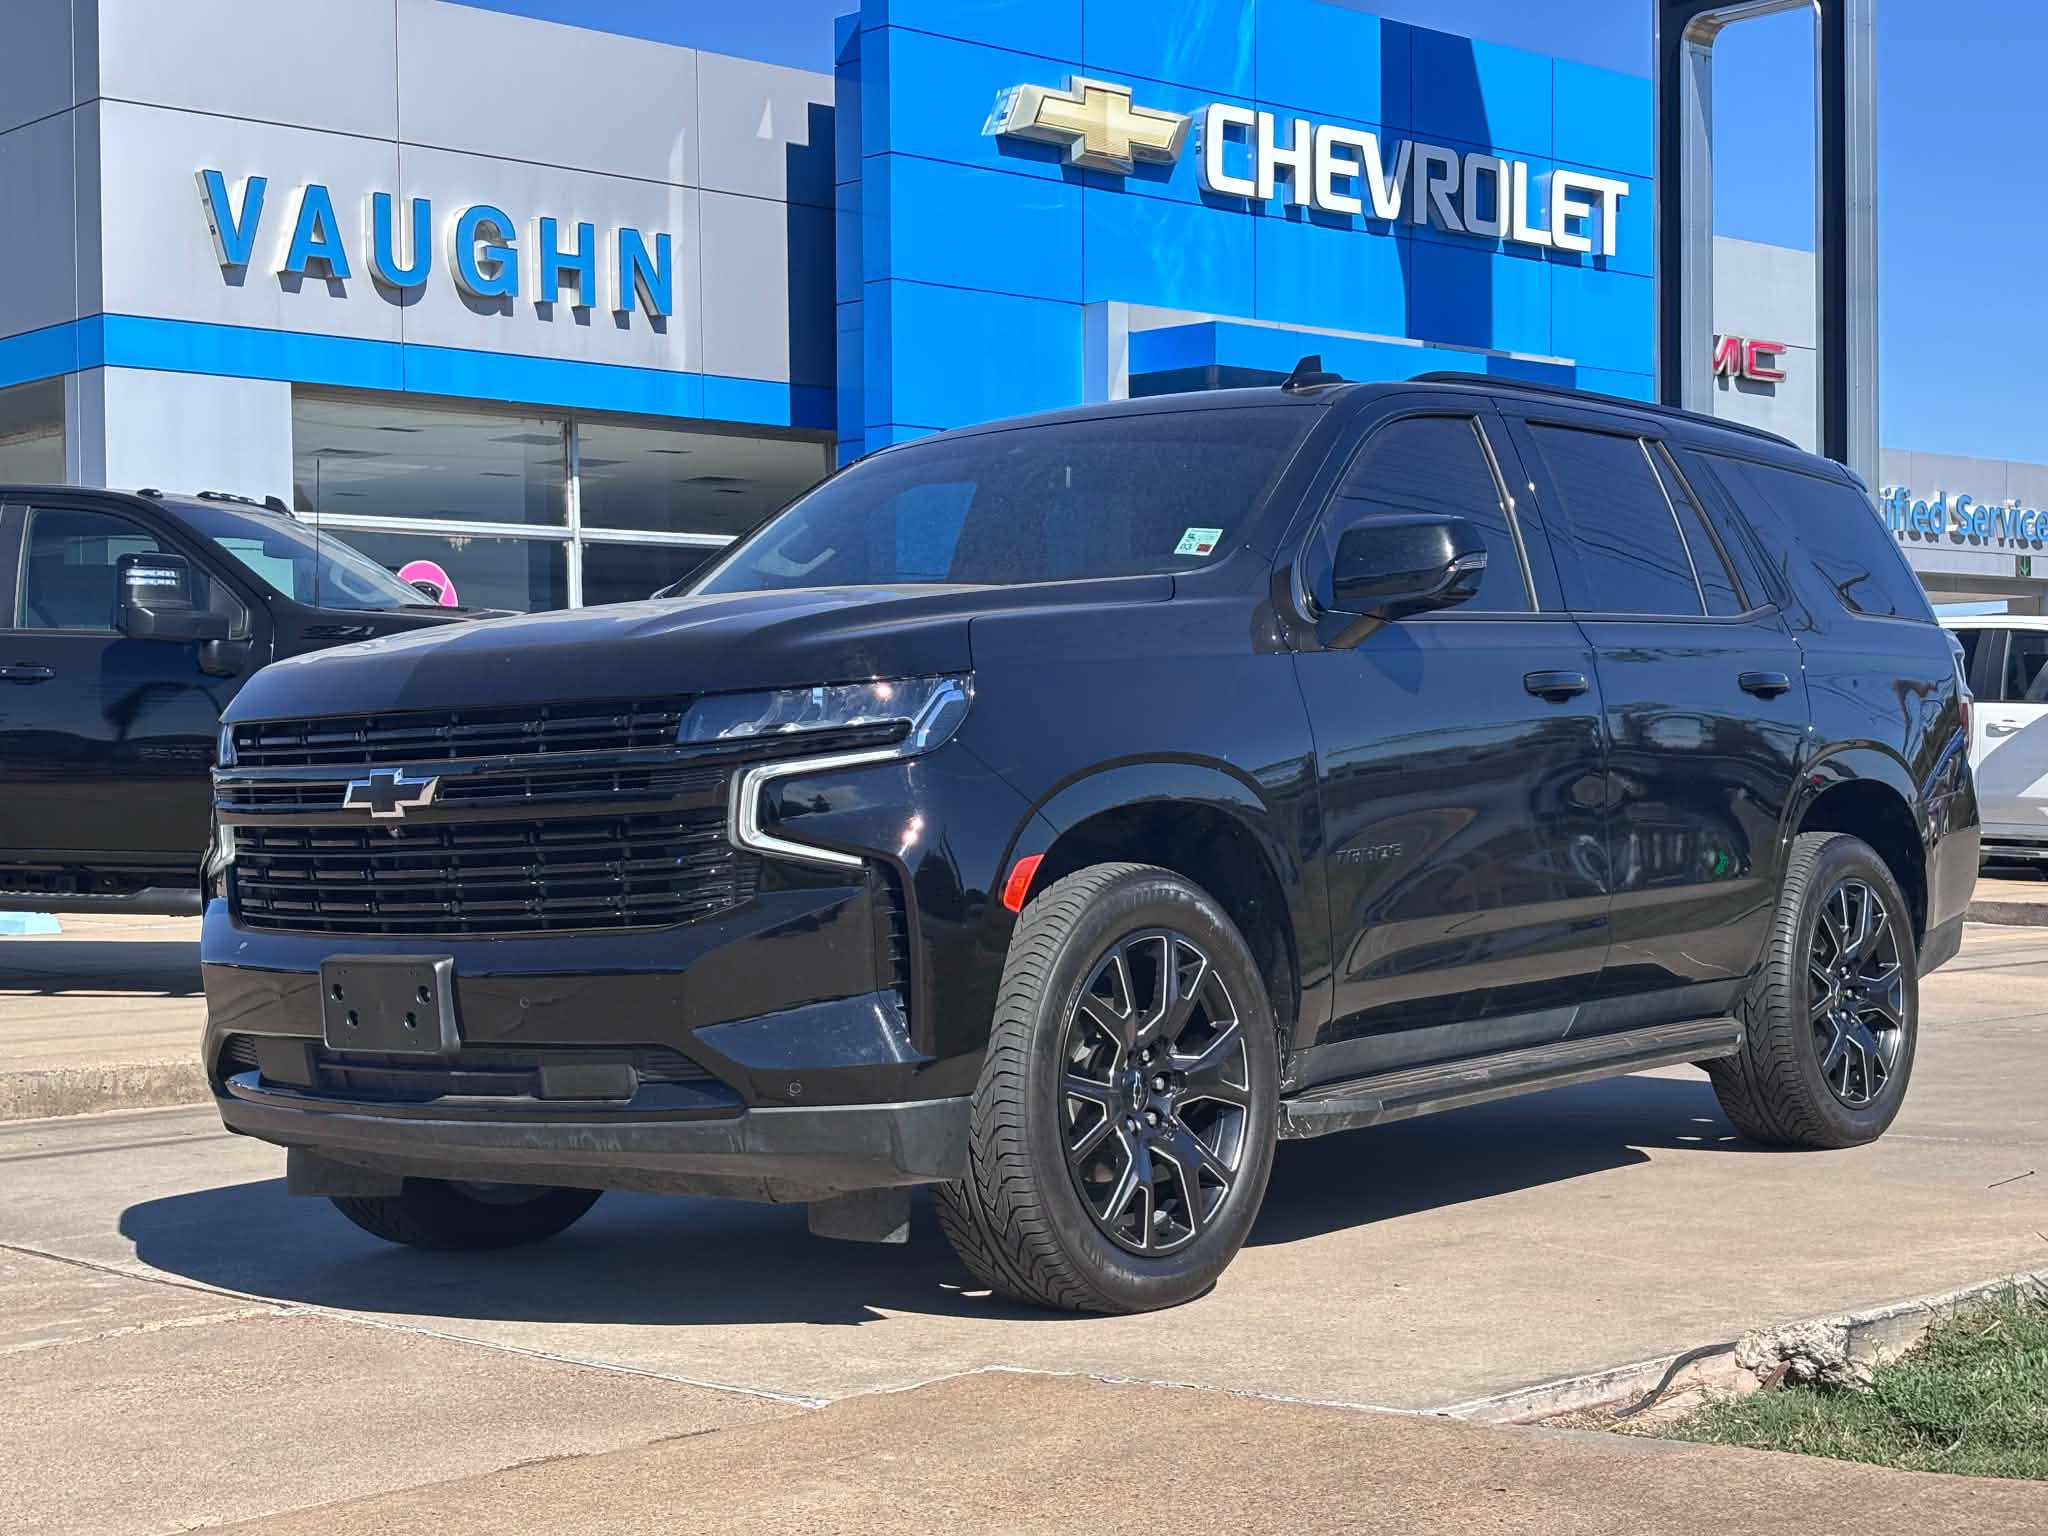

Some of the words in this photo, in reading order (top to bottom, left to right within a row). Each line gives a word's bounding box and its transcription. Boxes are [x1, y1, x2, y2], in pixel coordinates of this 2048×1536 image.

[196, 168, 672, 317] VAUGHN
[1201, 102, 1629, 256] CHEVROLET
[1880, 487, 1946, 535] ified
[1956, 494, 2048, 542] Service
